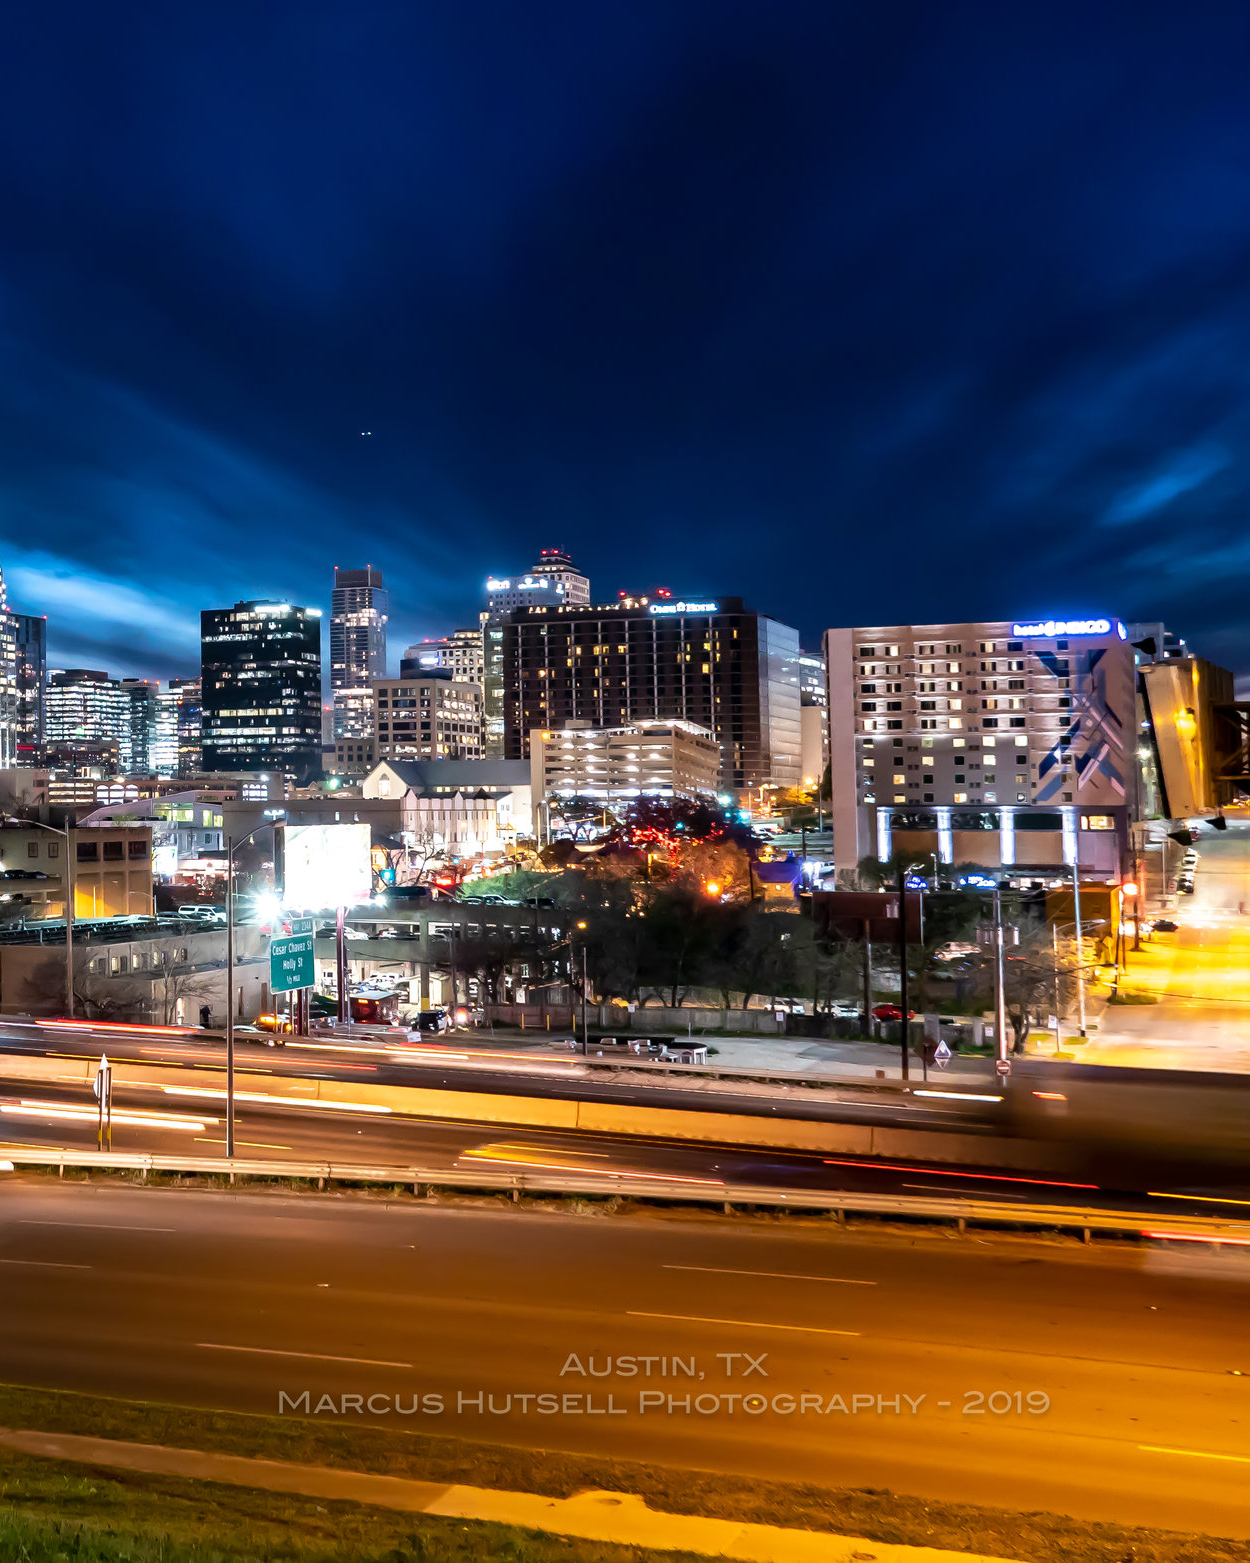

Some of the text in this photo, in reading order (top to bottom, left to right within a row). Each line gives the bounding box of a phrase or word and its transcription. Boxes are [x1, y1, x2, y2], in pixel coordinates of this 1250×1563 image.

[272, 941, 312, 956] Cesar Chavez St
[282, 957, 303, 971] Holly St
